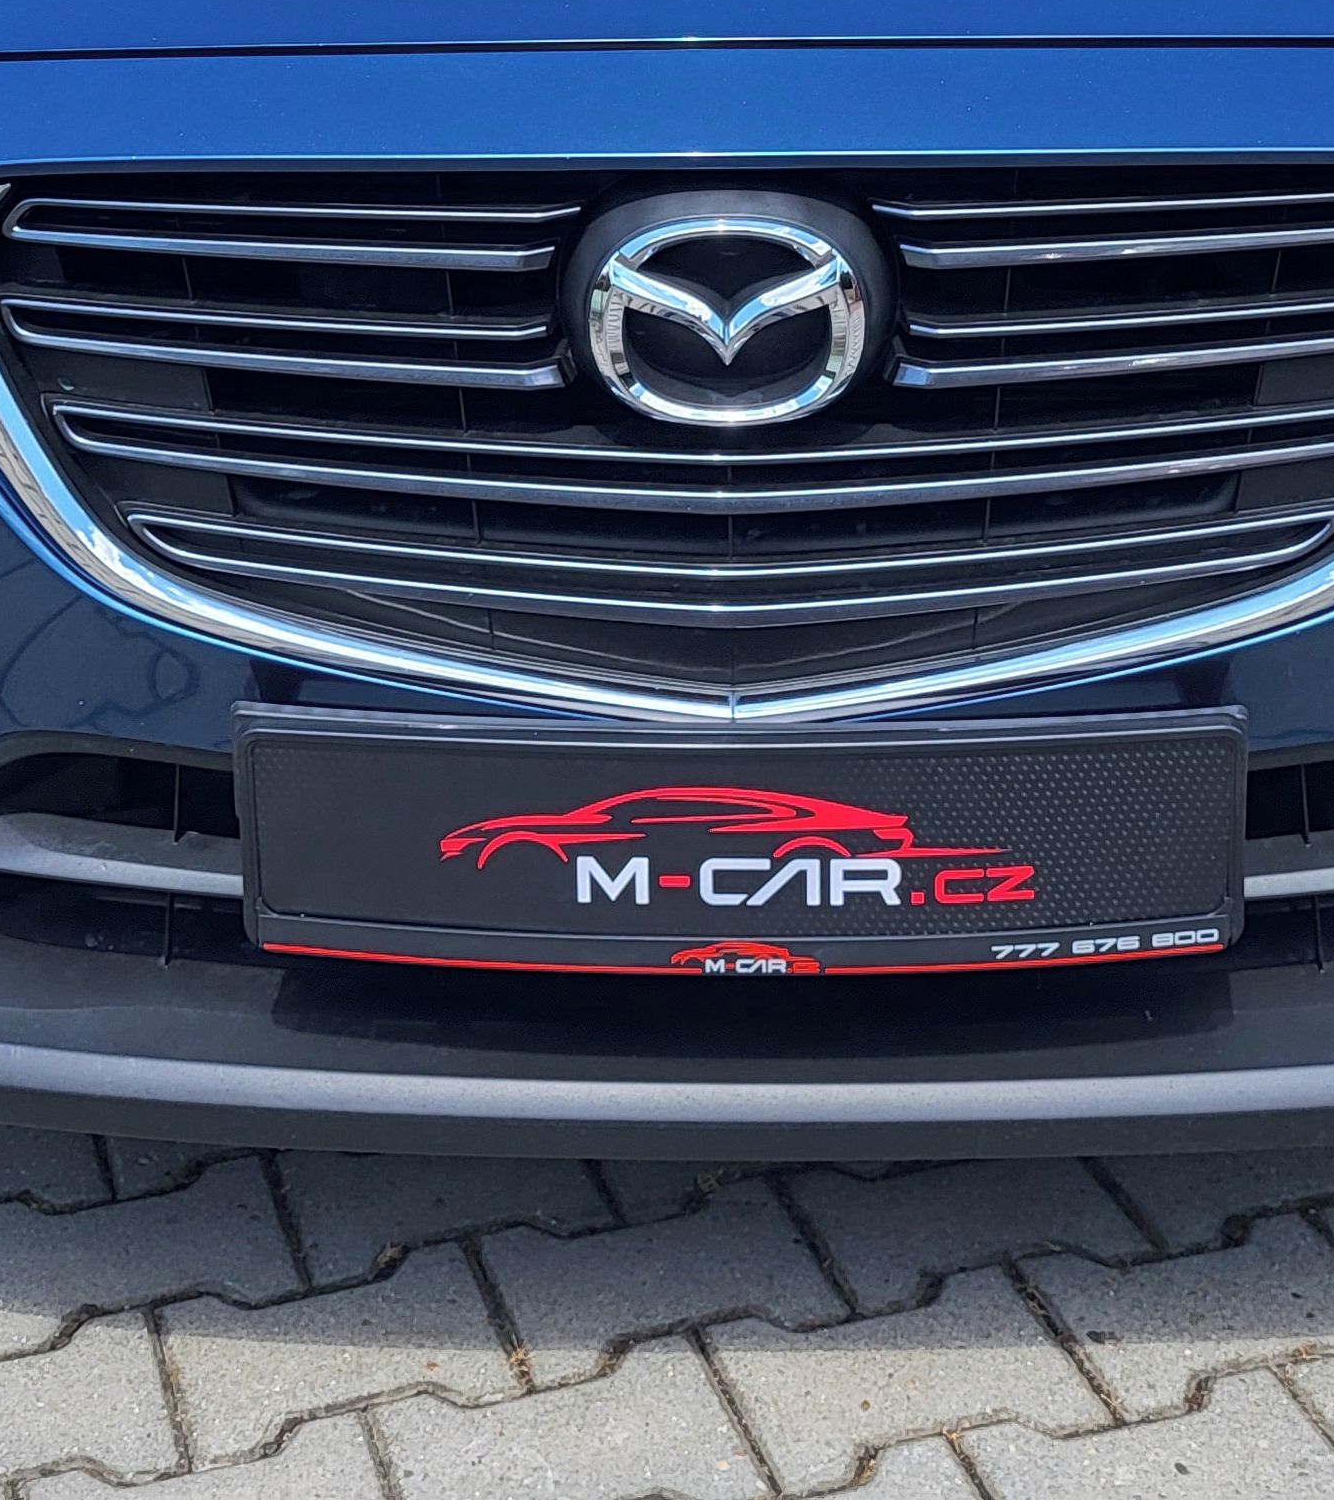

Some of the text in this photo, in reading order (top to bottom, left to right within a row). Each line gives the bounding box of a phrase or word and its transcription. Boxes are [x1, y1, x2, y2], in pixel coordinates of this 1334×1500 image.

[990, 927, 1220, 960] 777 676 800
